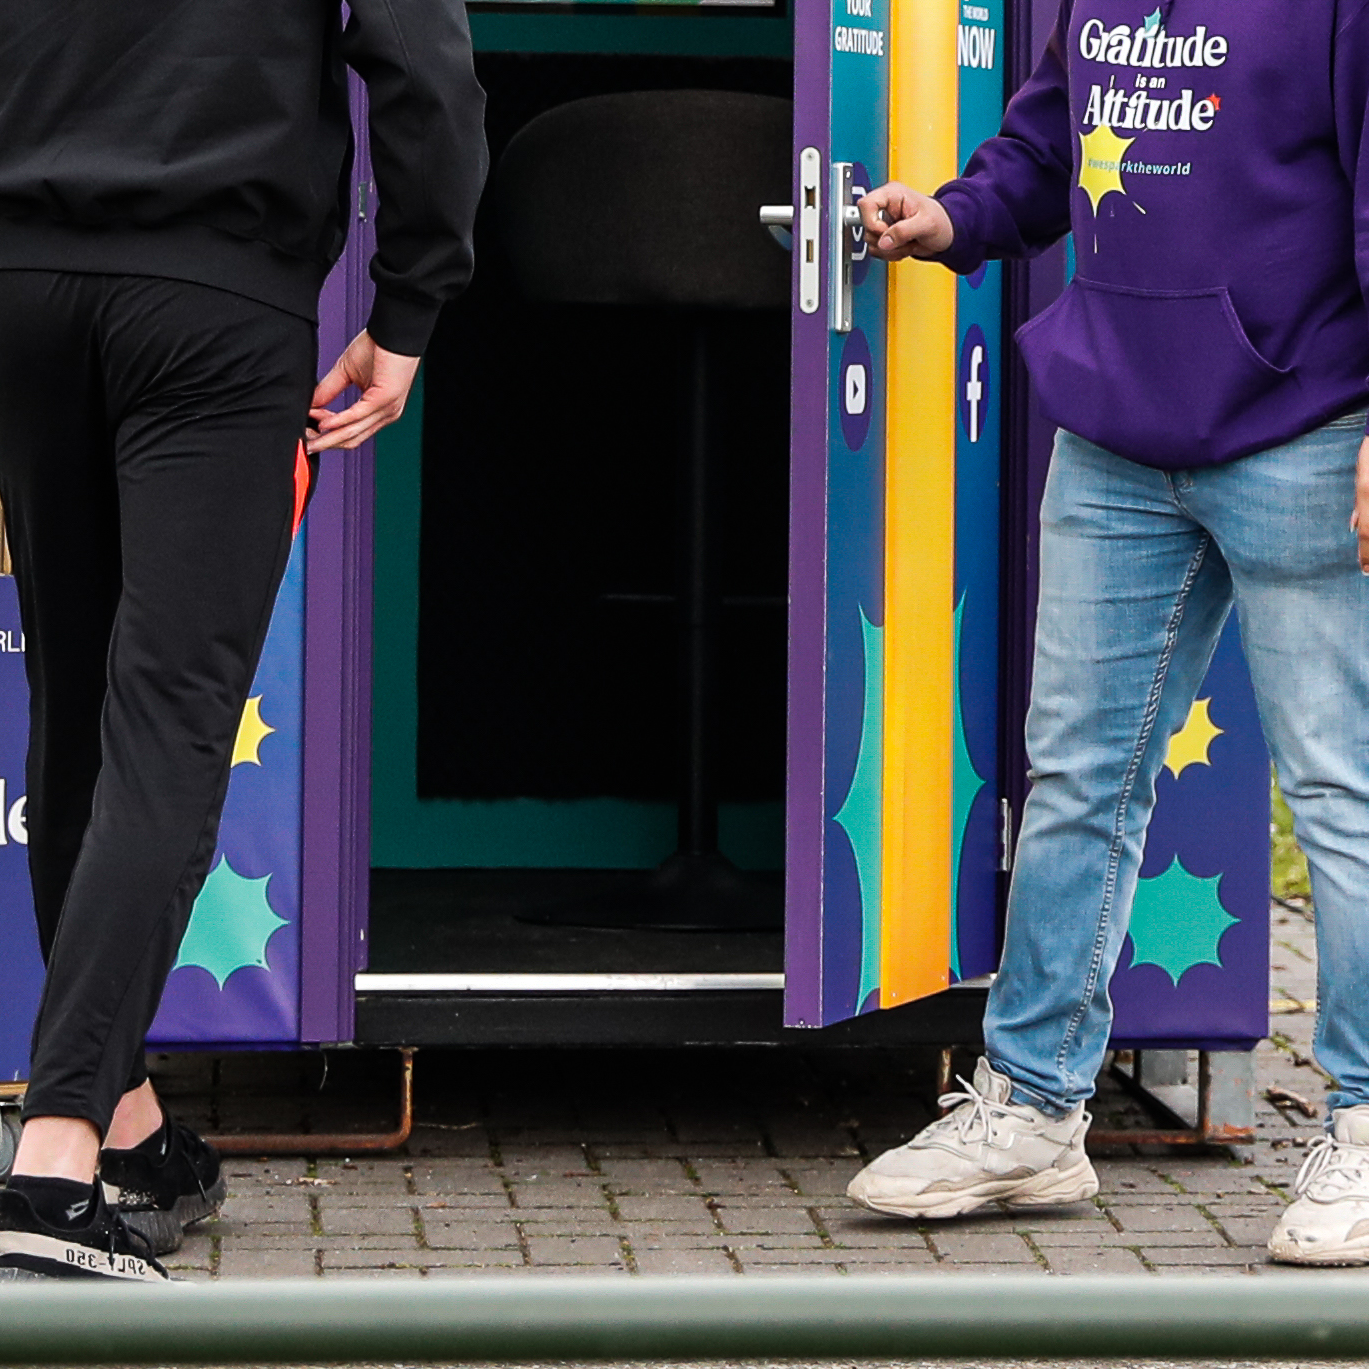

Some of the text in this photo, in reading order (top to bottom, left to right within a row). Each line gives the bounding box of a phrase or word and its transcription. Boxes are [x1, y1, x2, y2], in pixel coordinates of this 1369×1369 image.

[834, 26, 884, 56] GRATITUDE
[957, 24, 995, 69] NOW
[1080, 18, 1229, 68] Gratitude
[1135, 74, 1166, 88] is an
[1082, 84, 1215, 131] Attitude
